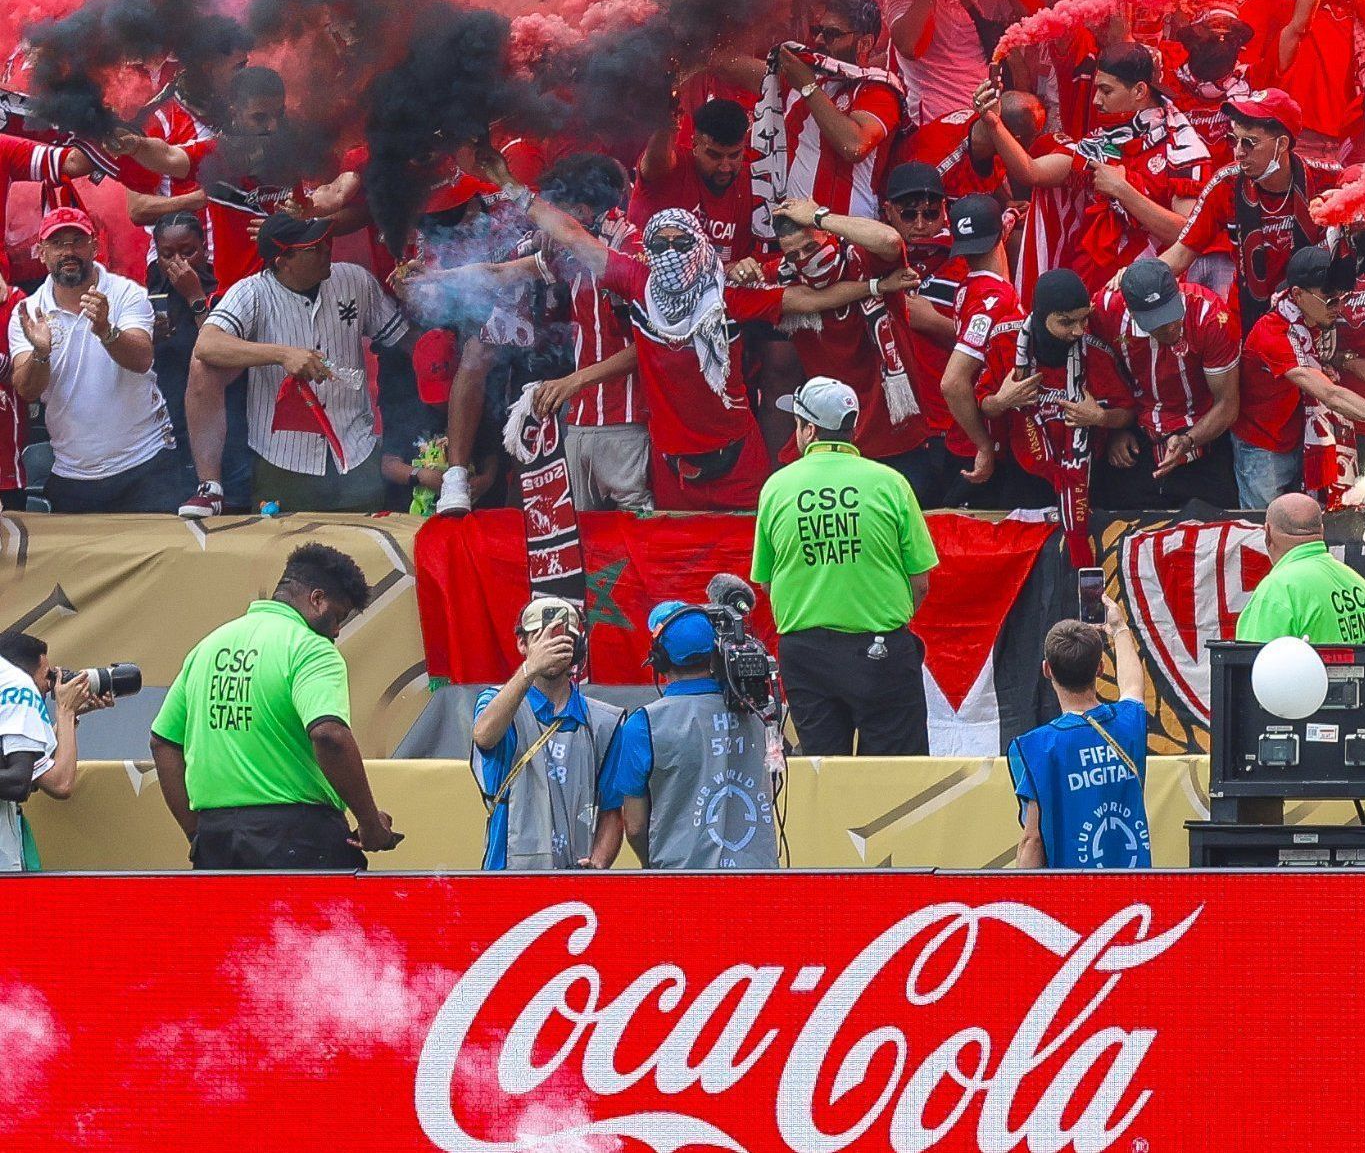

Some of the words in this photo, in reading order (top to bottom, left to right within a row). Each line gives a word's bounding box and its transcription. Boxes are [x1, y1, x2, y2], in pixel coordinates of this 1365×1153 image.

[797, 486, 859, 513] CSC
[797, 512, 860, 541] EVENT
[802, 539, 862, 566] STAFF
[215, 648, 258, 673] CSC
[210, 675, 251, 702] EVENT
[209, 704, 252, 731] STAFF
[712, 713, 740, 731] HB
[1079, 745, 1119, 767] FIFA
[1067, 765, 1135, 791] DIGITAL
[693, 786, 711, 827] CLUB
[757, 792, 772, 824] CUP
[1077, 821, 1093, 864] CLUB
[1093, 801, 1132, 819] WORLD
[1135, 820, 1150, 851] CUP
[414, 900, 1206, 1153] Coca-Cola
